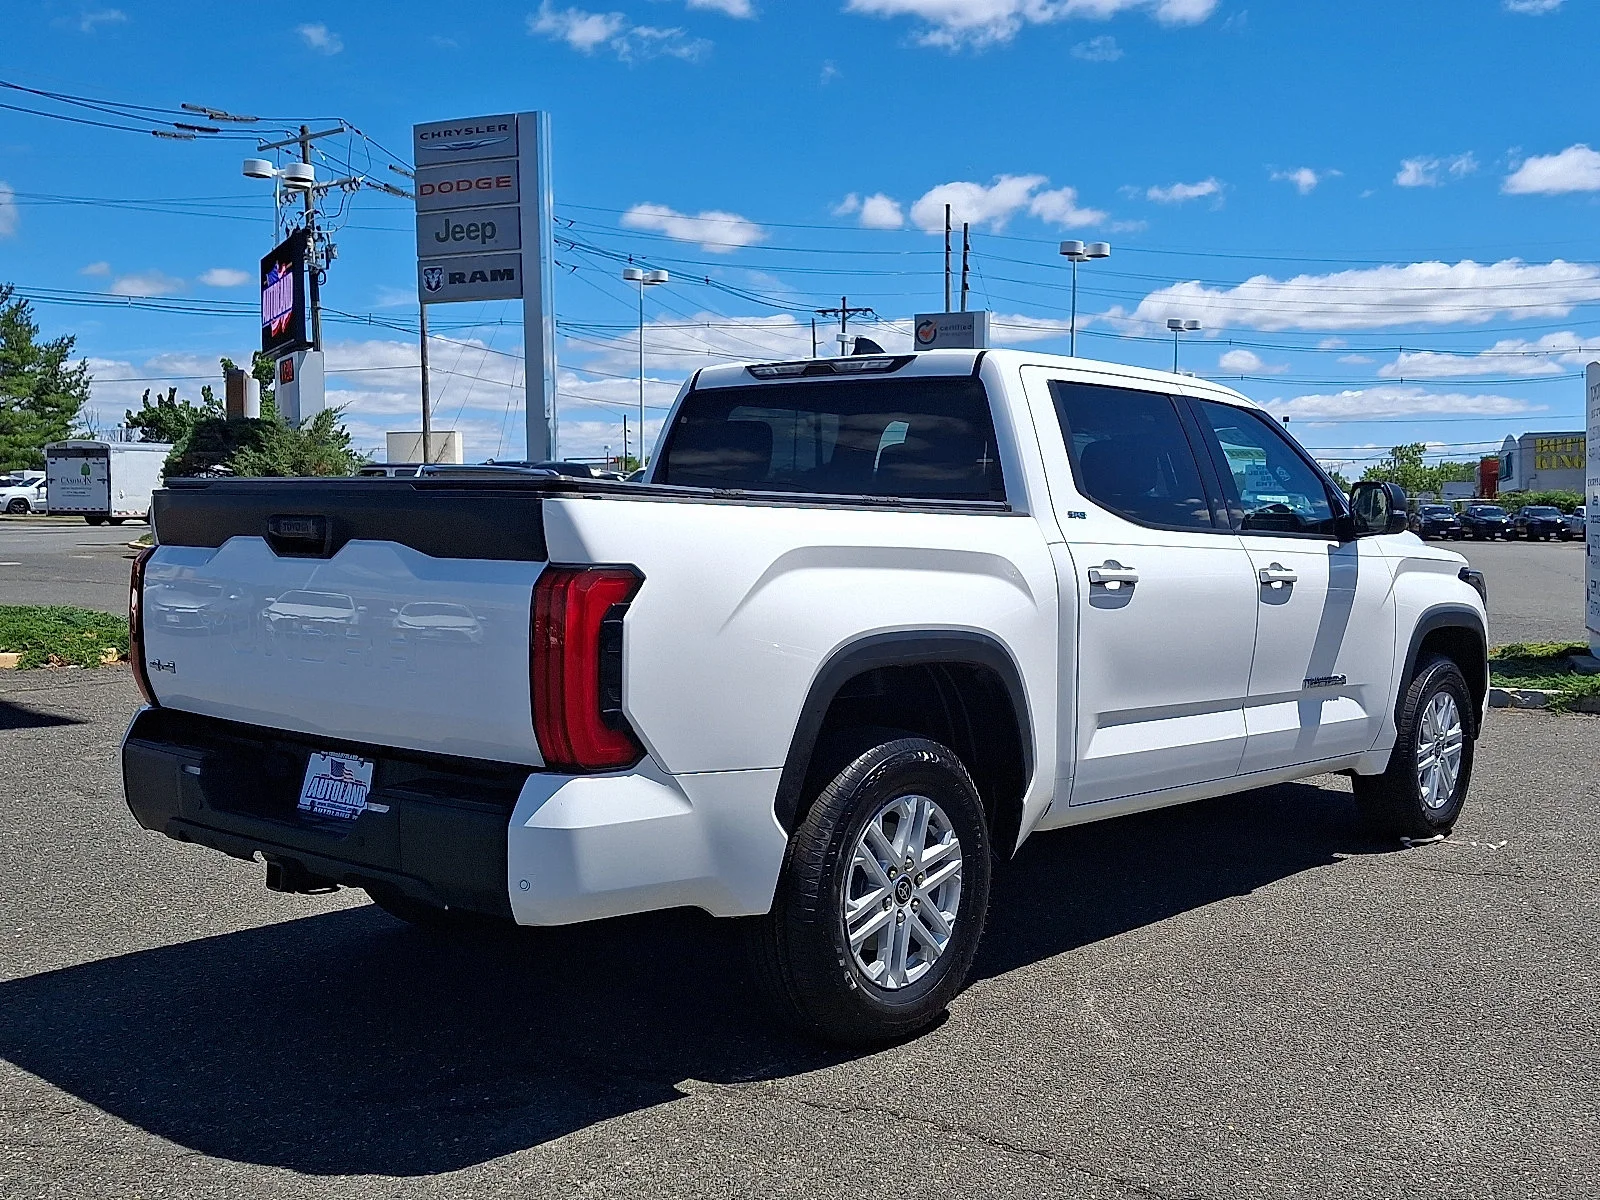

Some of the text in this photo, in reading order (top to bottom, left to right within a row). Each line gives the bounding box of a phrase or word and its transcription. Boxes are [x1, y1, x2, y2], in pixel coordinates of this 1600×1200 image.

[420, 124, 508, 140] CHRYSLER
[420, 175, 512, 196] DODGE
[435, 218, 497, 244] Jeep
[449, 268, 515, 285] RAM
[1535, 455, 1585, 469] KING
[306, 777, 367, 807] AUTOLAND
[313, 806, 351, 819] AUTOLAND
